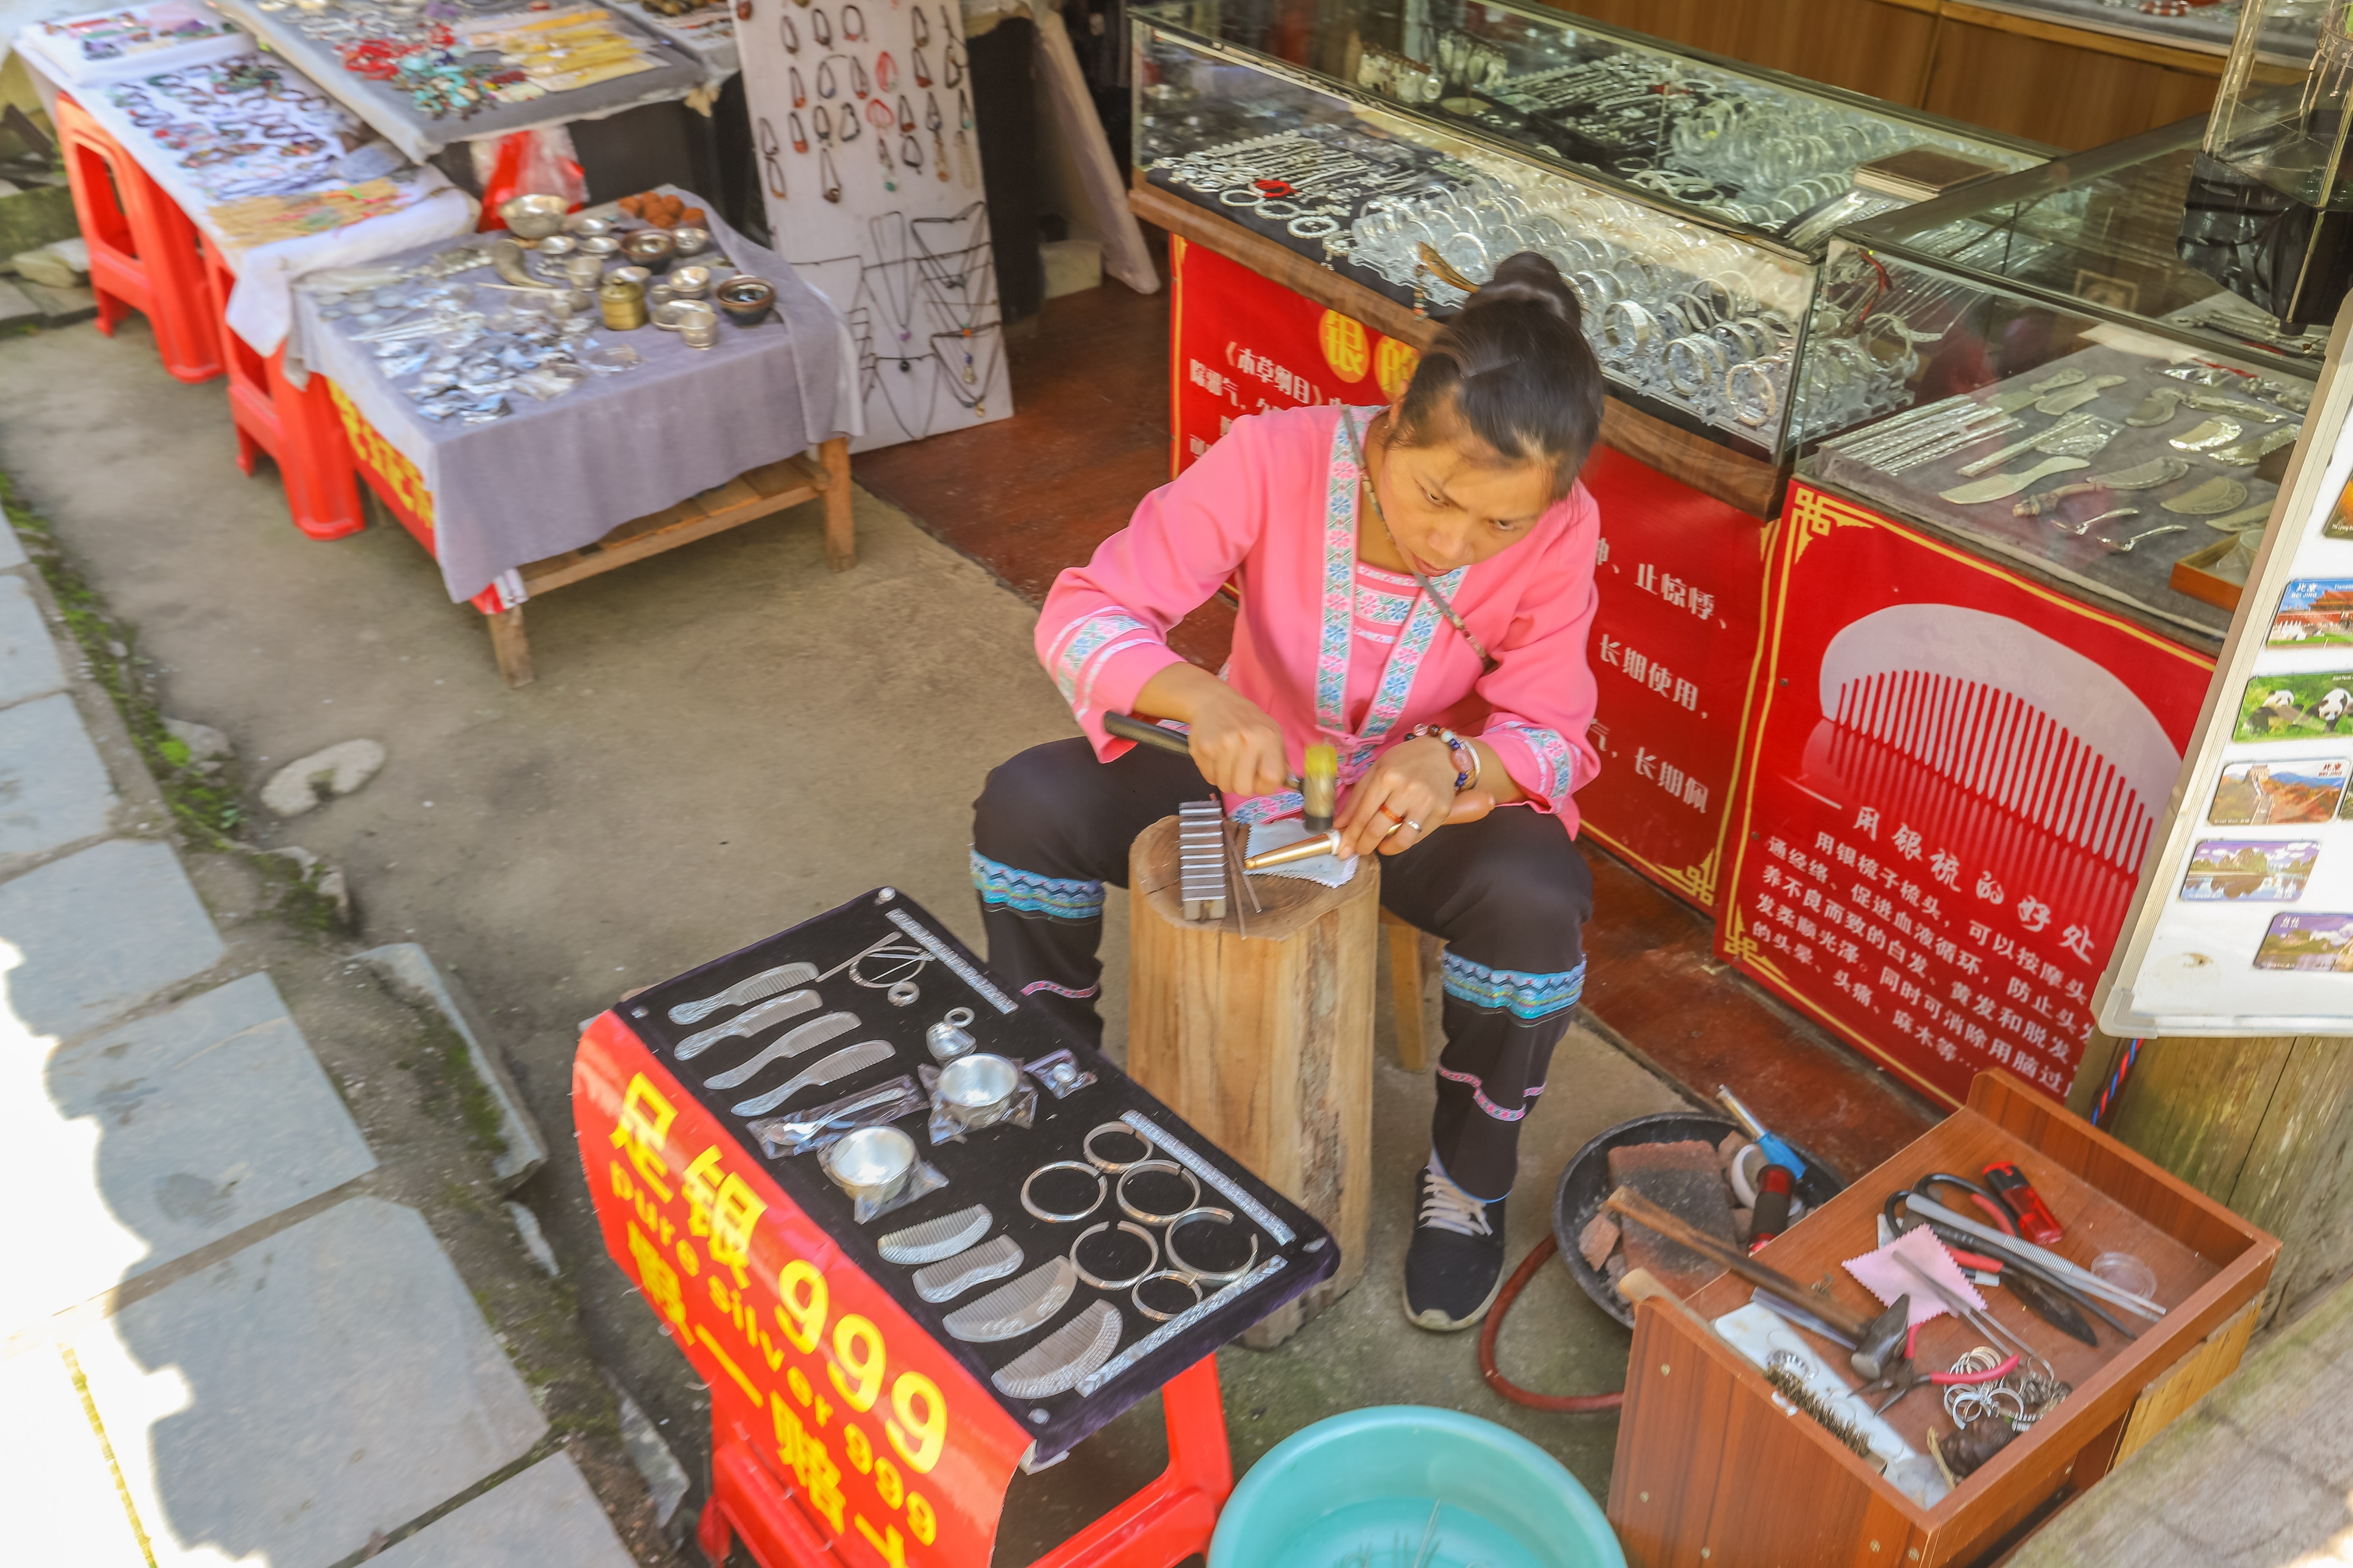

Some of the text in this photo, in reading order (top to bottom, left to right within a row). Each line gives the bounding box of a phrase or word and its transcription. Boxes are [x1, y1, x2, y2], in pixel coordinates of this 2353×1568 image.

[1599, 633, 1707, 719] 长期使用，
[1755, 892, 2073, 1098] 发柔顺光泽。同时可消除用脑过
[610, 1160, 936, 1547] pure silver 999
